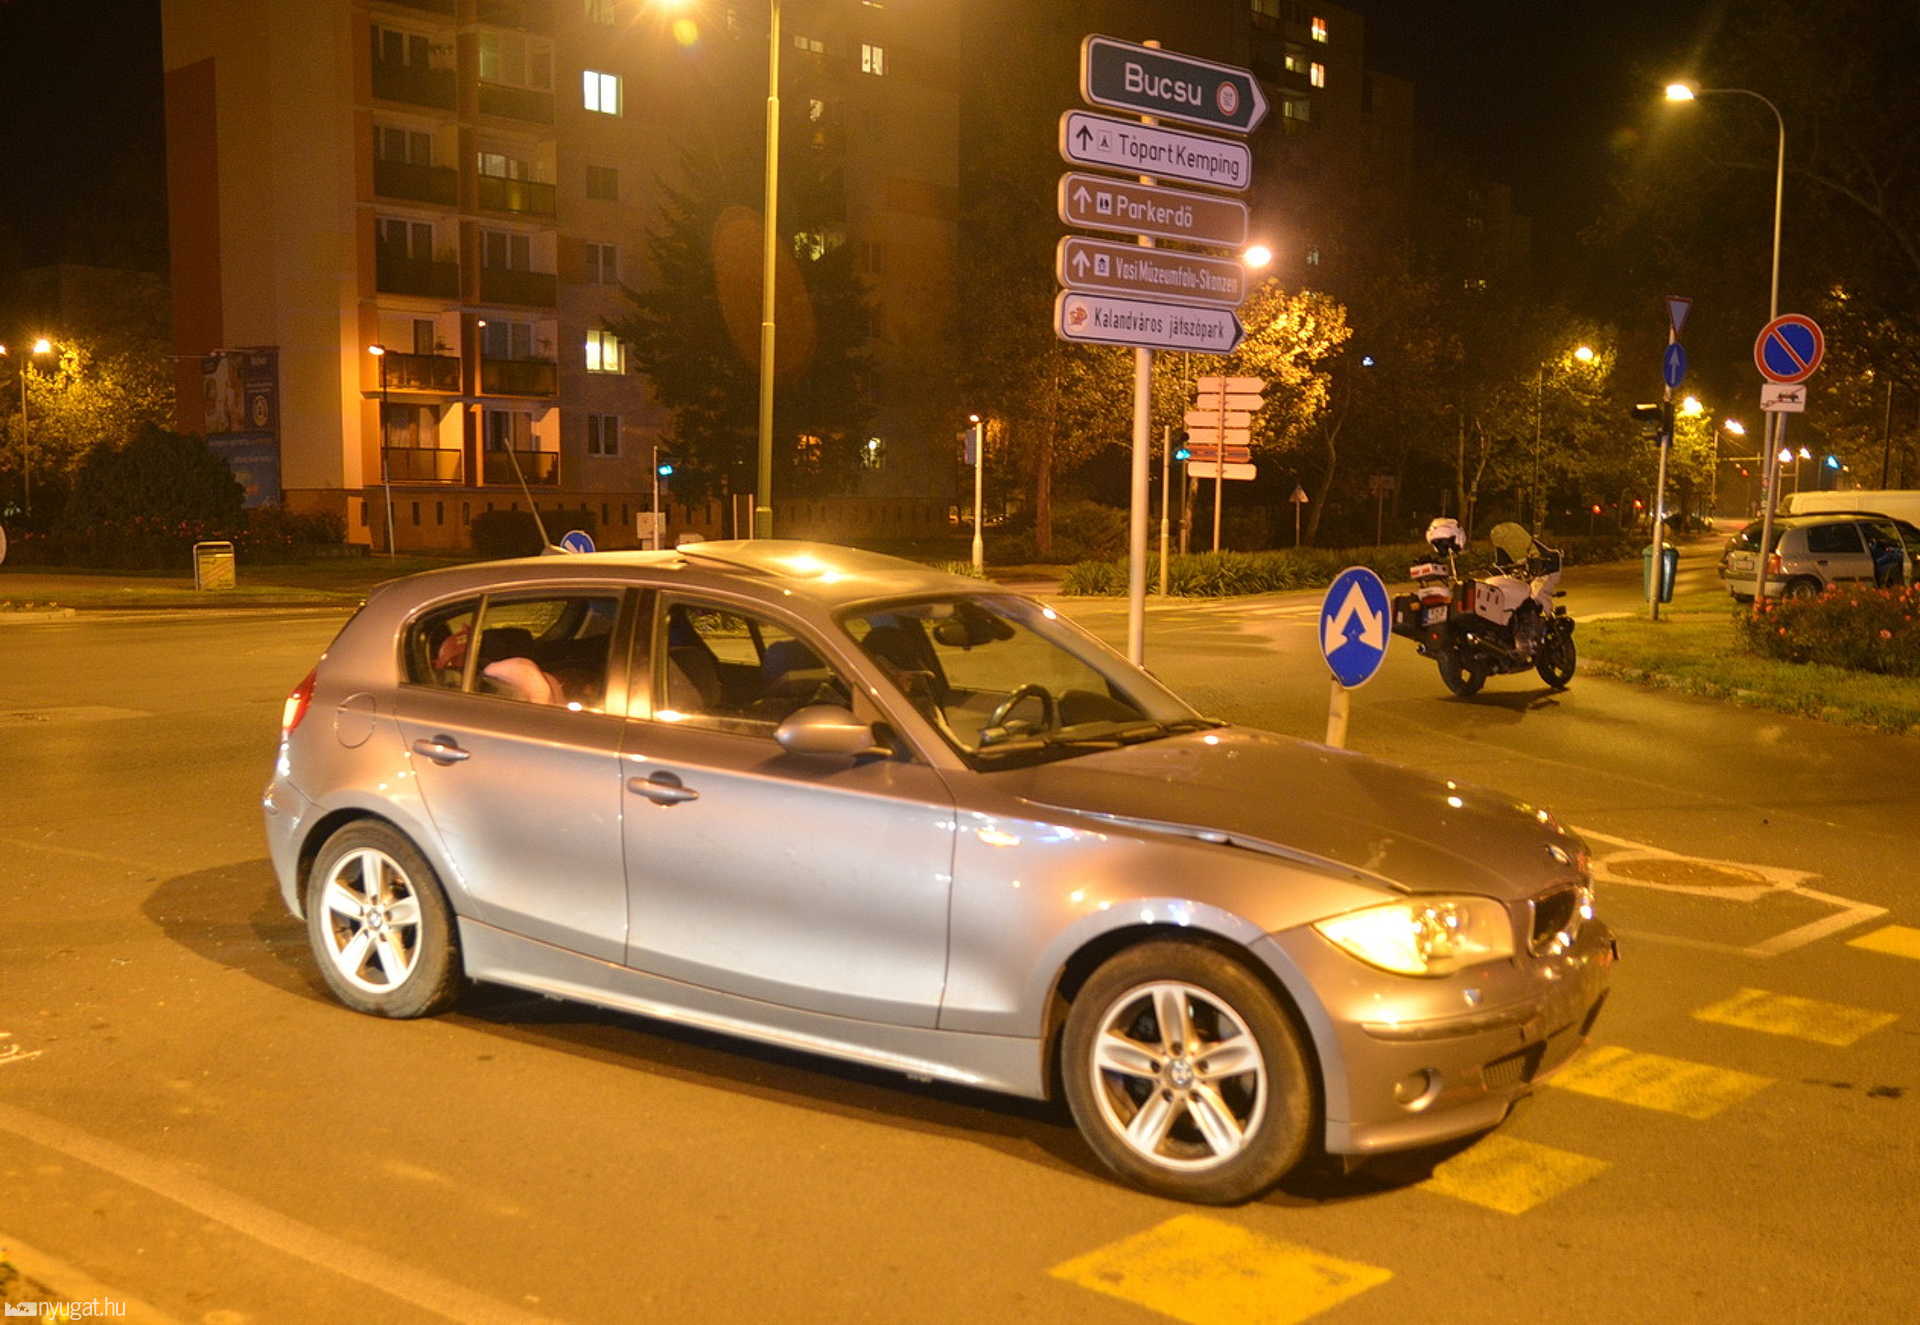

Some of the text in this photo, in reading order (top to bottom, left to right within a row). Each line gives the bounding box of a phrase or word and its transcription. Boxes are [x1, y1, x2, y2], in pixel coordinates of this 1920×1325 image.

[1124, 62, 1202, 106] Bucsu
[1176, 146, 1240, 181] Kemping
[1094, 307, 1225, 342] Kalandváros játszópark
